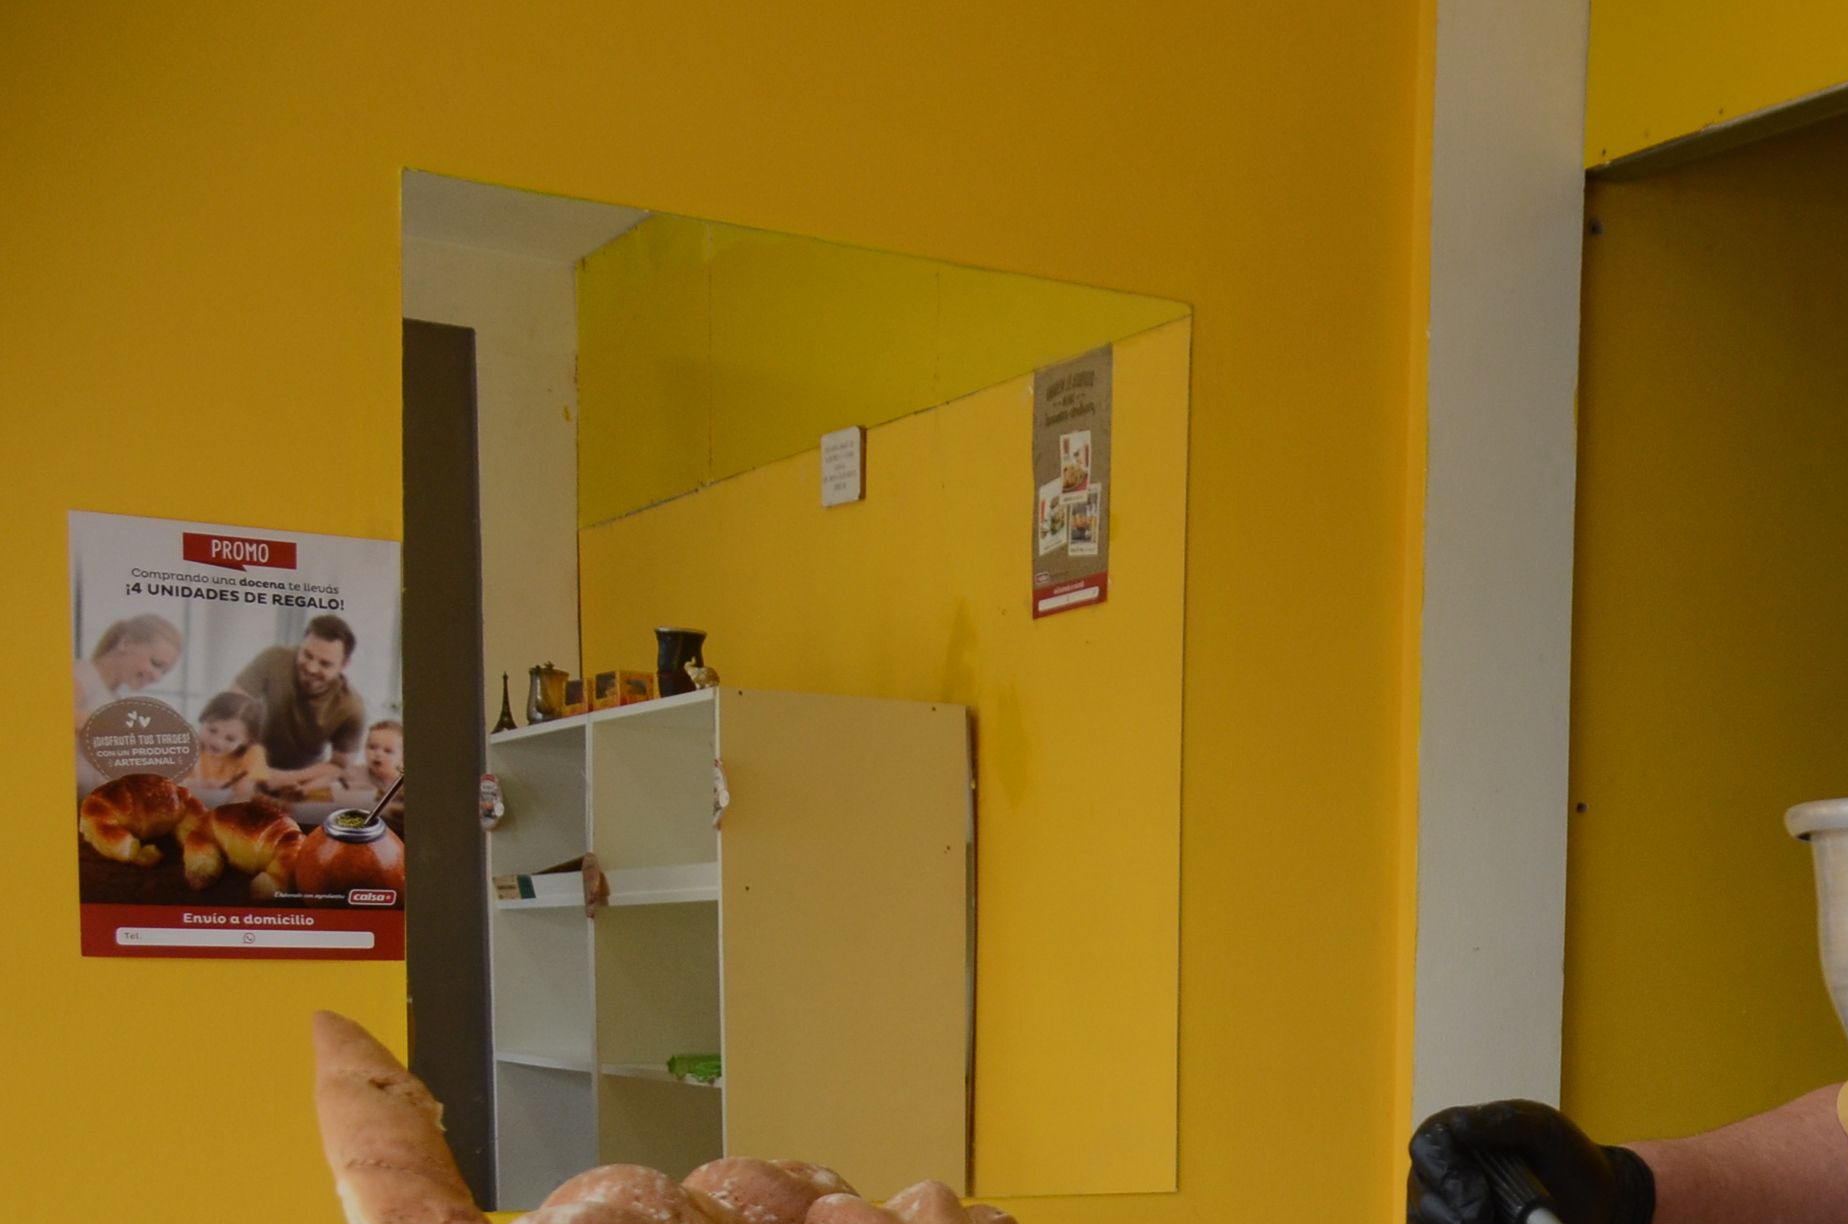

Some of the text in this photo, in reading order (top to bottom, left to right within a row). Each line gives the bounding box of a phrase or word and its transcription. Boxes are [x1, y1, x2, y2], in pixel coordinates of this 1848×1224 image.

[210, 538, 270, 564] PROMO
[131, 567, 210, 584] Comprando
[212, 576, 236, 586] una
[239, 576, 286, 590] docena
[288, 582, 301, 592] te
[126, 582, 345, 611] ¡4 UNIDADES DE REGALO!
[96, 750, 116, 758] CON
[132, 746, 190, 756] PRODUCTO
[114, 756, 176, 767] ARTESANAL
[352, 892, 385, 902] calsa
[230, 915, 240, 924] a
[243, 913, 315, 926] domicilio
